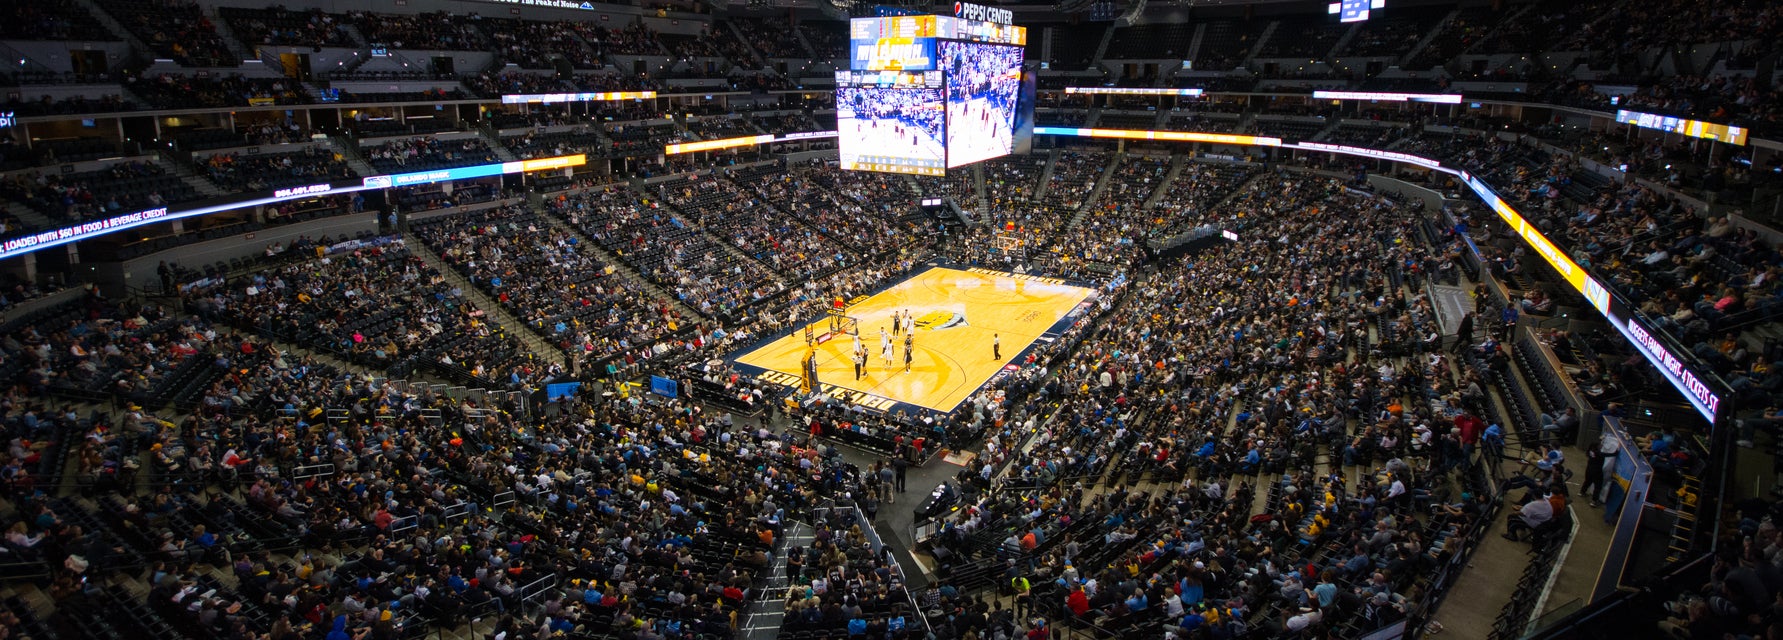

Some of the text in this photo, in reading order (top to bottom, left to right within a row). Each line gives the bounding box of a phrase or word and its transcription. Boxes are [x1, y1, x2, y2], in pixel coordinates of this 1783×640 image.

[561, 1, 579, 9] Noise
[963, 2, 1013, 25] PEPSI CENTER
[396, 171, 450, 185] ORLANDO MAGIC
[5, 236, 38, 251] LOADED
[38, 231, 58, 244] WITH
[58, 228, 73, 239] $60
[73, 226, 82, 236] IN
[82, 222, 103, 234] FOOD
[103, 219, 109, 229] &
[109, 212, 143, 227] BEVERAGE
[142, 207, 167, 220] CREDIT
[1627, 318, 1649, 347] NUGGETS
[1647, 335, 1666, 362] FAMILY
[1681, 369, 1688, 383] 4
[1685, 371, 1710, 405] TICKETS
[1708, 393, 1719, 413] ST
